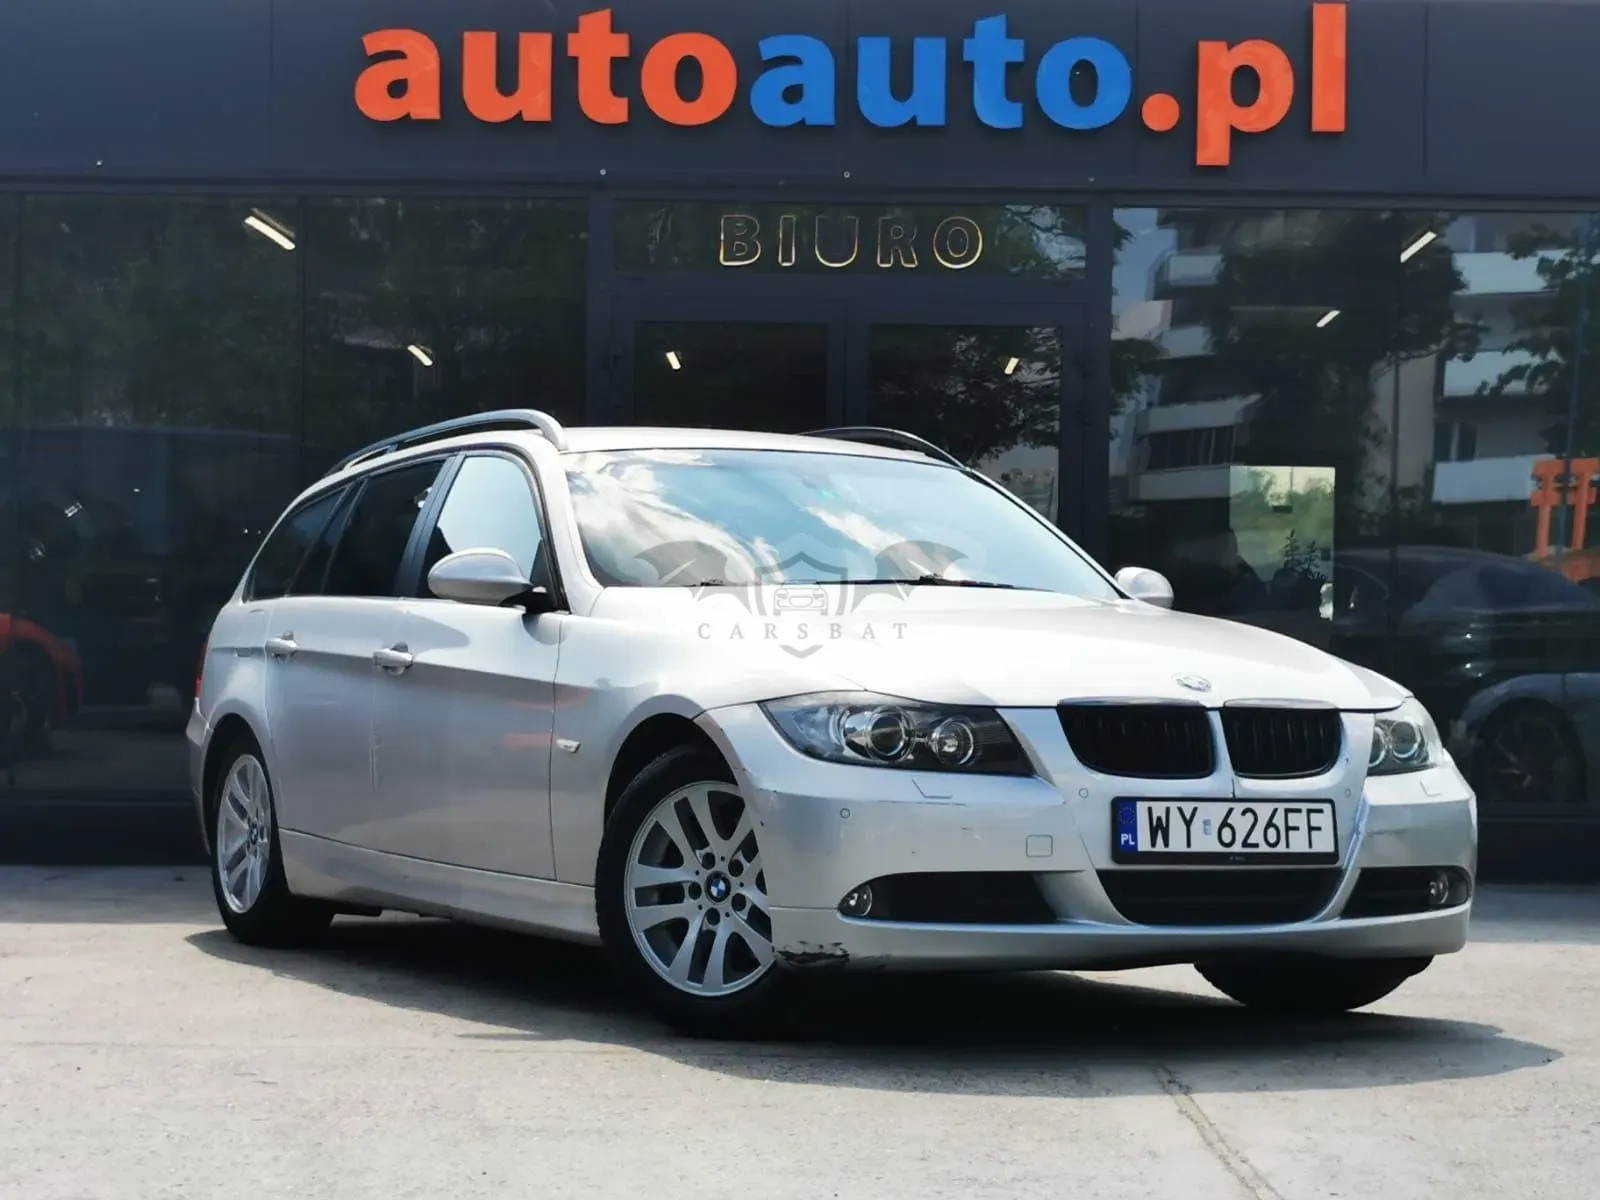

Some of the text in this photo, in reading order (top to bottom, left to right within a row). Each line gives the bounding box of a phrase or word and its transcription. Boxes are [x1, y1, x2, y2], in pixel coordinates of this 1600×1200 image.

[354, 3, 1347, 166] autoauto.pl
[719, 214, 984, 269] BIURO
[1120, 833, 1136, 846] PL
[1147, 806, 1324, 849] WY 626FF
